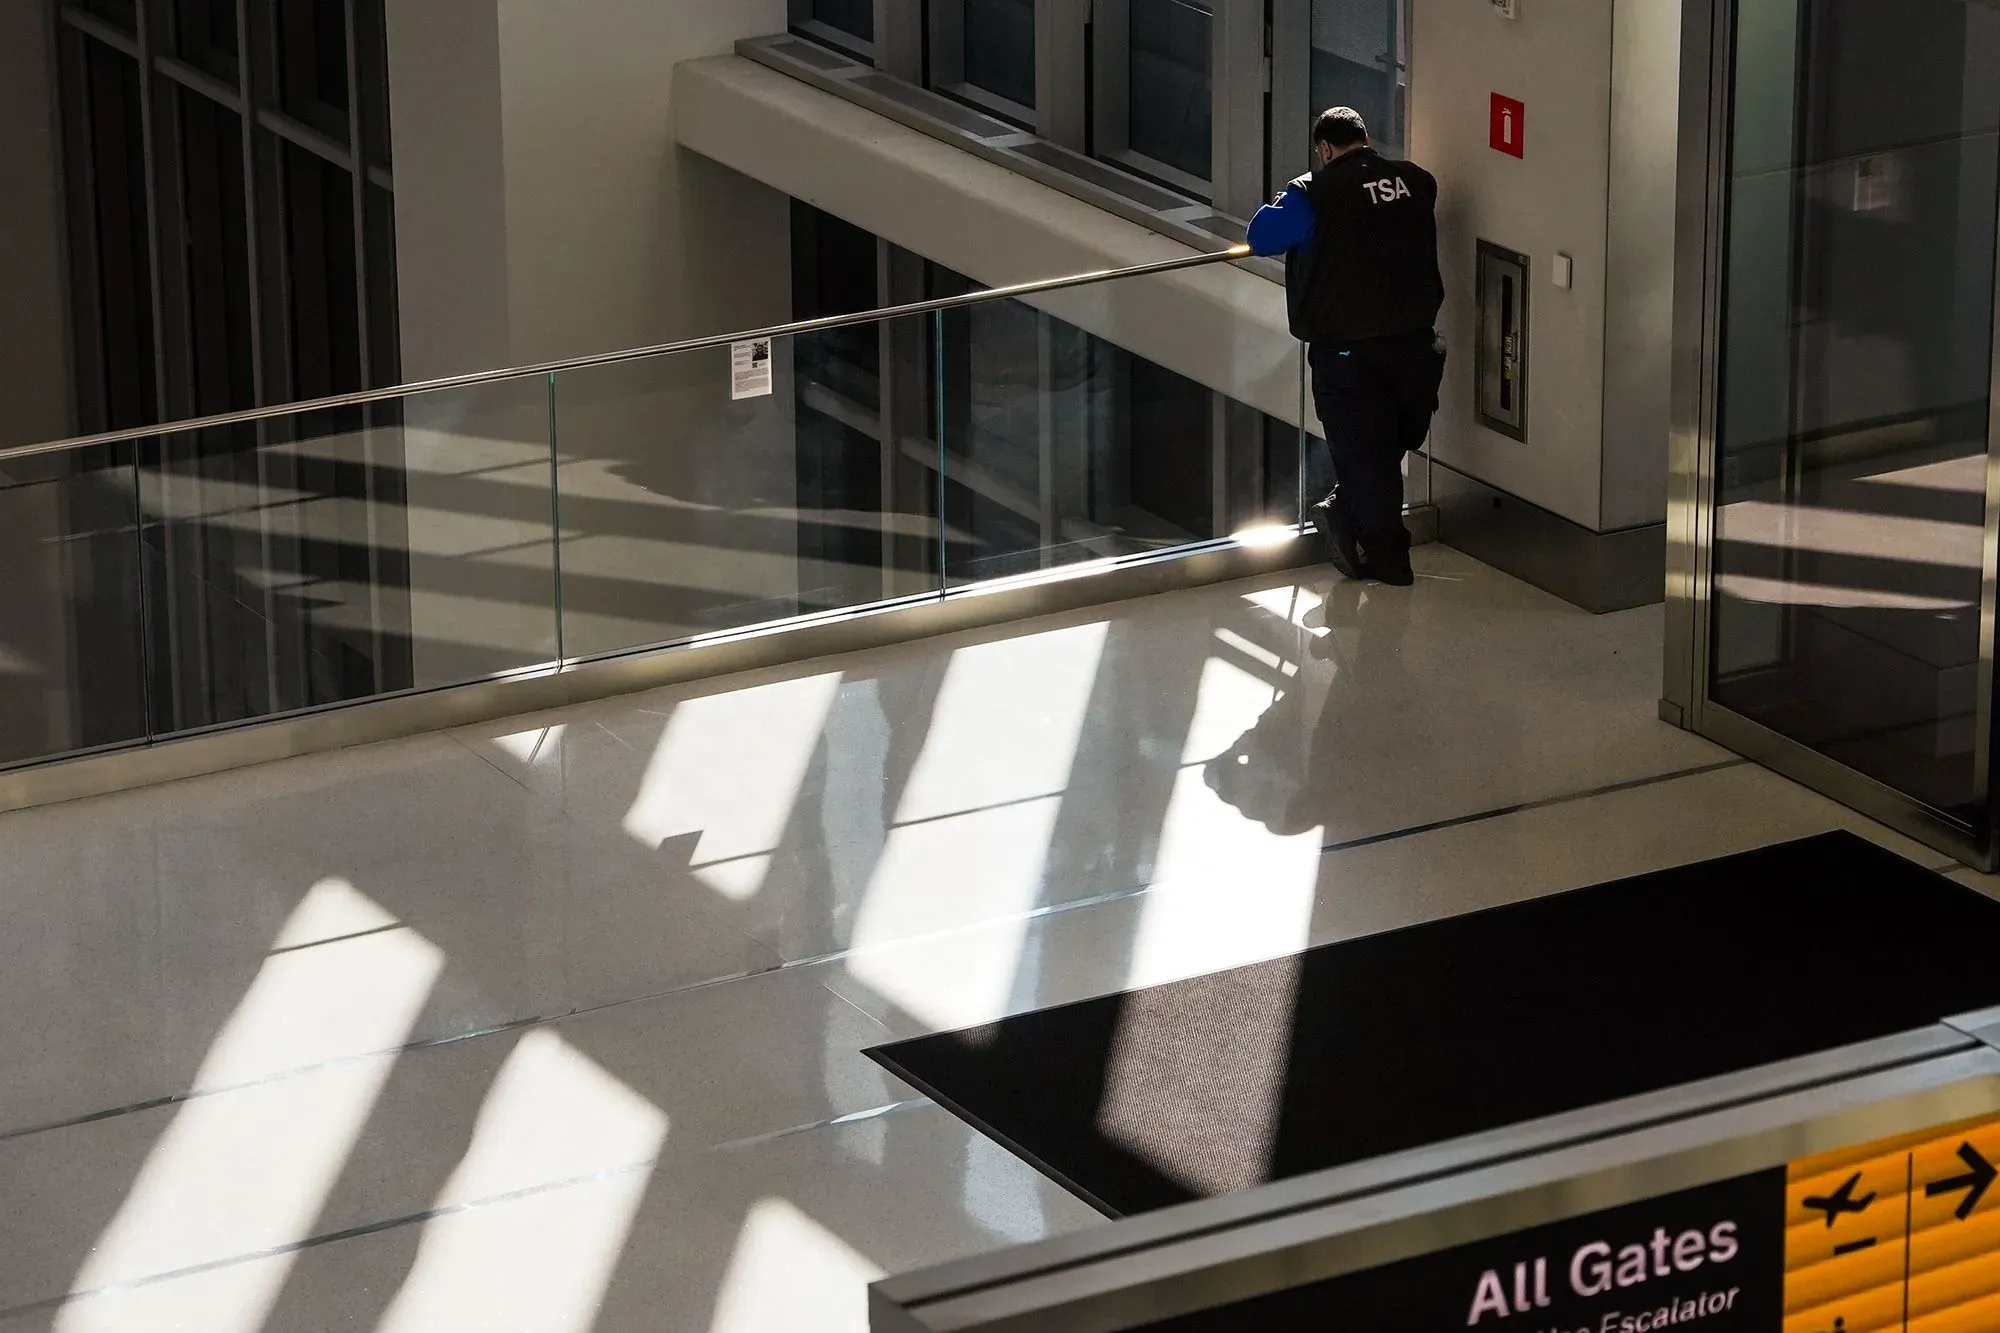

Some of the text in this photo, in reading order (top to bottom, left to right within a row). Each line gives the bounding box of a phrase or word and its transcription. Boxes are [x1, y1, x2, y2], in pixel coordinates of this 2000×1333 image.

[1362, 176, 1411, 204] TSA
[1467, 1220, 1739, 1325] All Gates
[1600, 1287, 1740, 1333] Escalator
